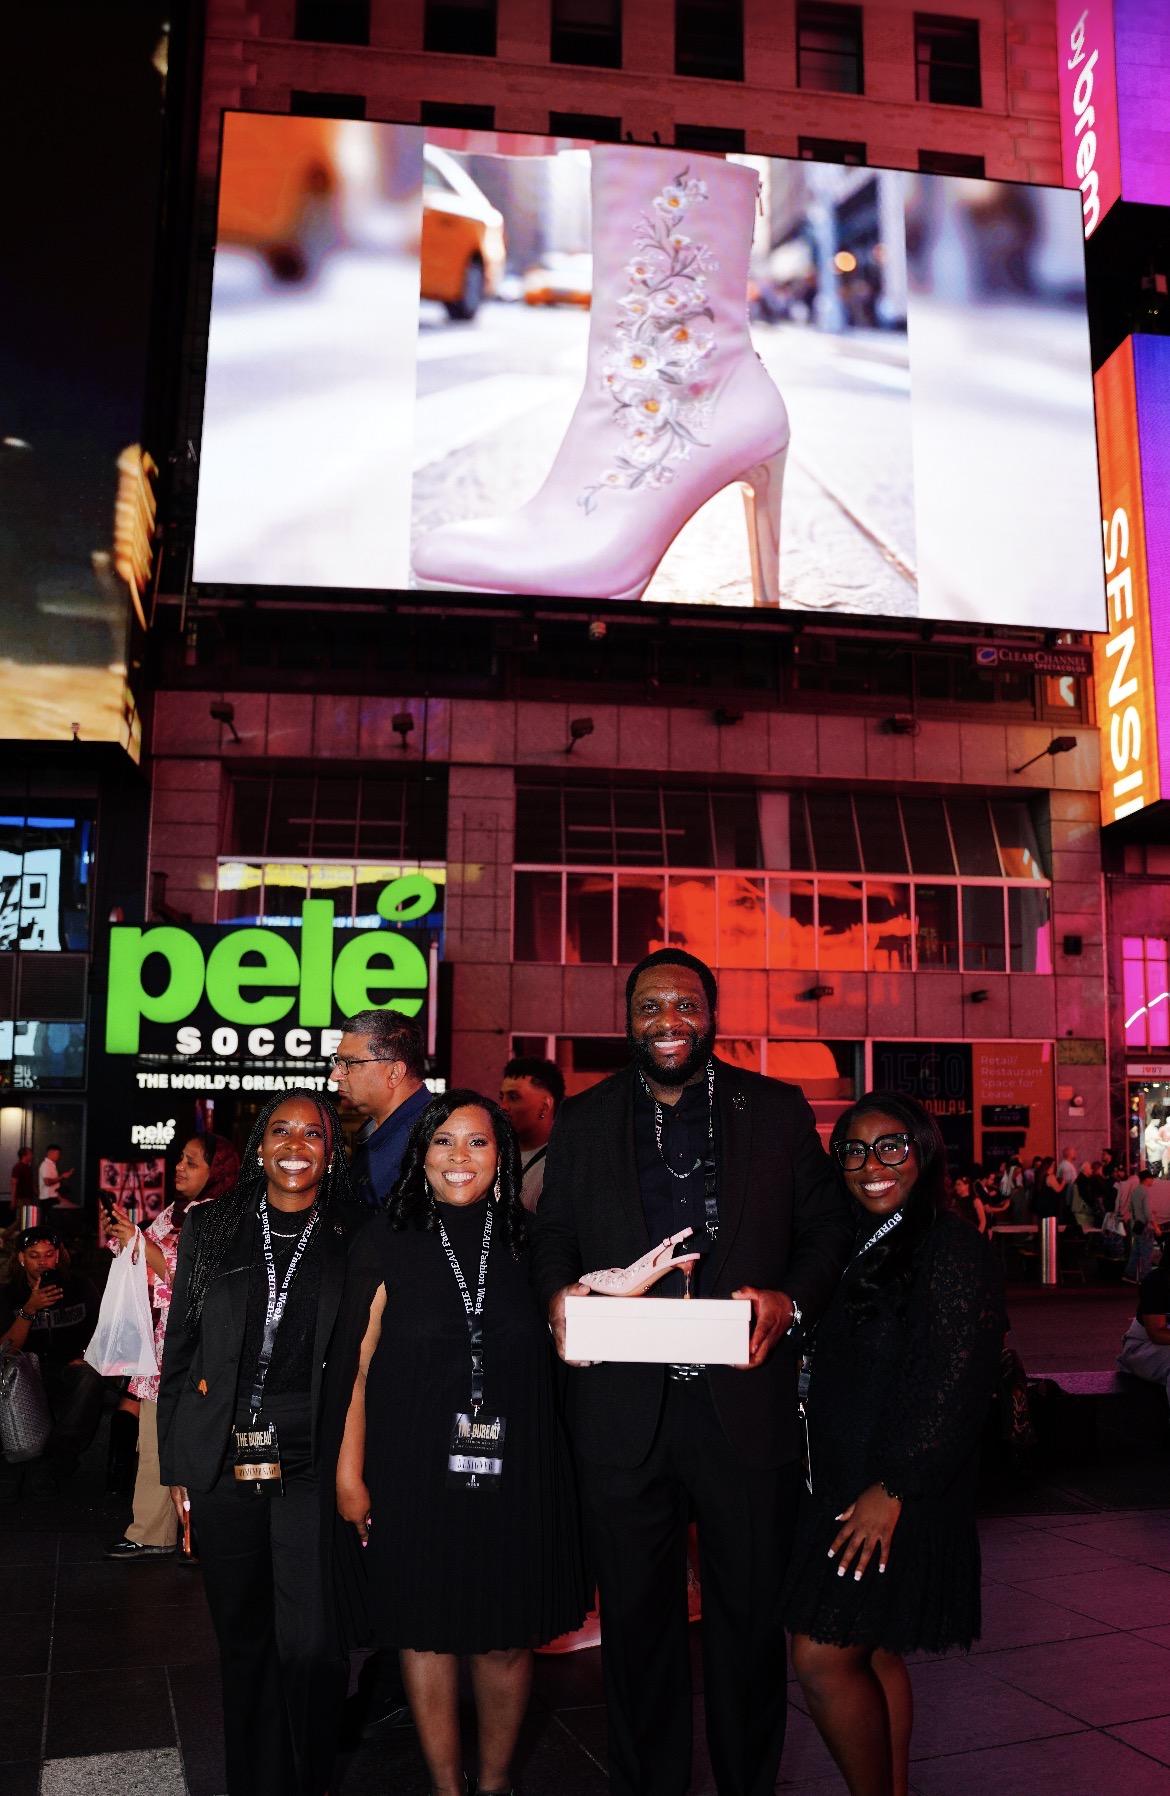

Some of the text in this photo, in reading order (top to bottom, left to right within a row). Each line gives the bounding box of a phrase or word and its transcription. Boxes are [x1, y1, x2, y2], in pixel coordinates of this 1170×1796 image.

[105, 874, 436, 1055] pelé
[176, 1026, 344, 1057] SOCCE
[136, 1072, 169, 1088] THE
[171, 1073, 241, 1090] WORLD'S
[242, 1075, 326, 1092] GREATEST
[131, 1118, 177, 1144] pelé
[260, 1211, 272, 1250] Fashion
[864, 1212, 903, 1250] BUREAU
[281, 1251, 303, 1289] Fashion
[444, 1248, 468, 1289] BUREAU
[474, 1210, 493, 1315] BUREAU Fashion Week
[265, 1301, 276, 1326] THE
[272, 1292, 288, 1322] Week
[461, 1290, 475, 1314] THE
